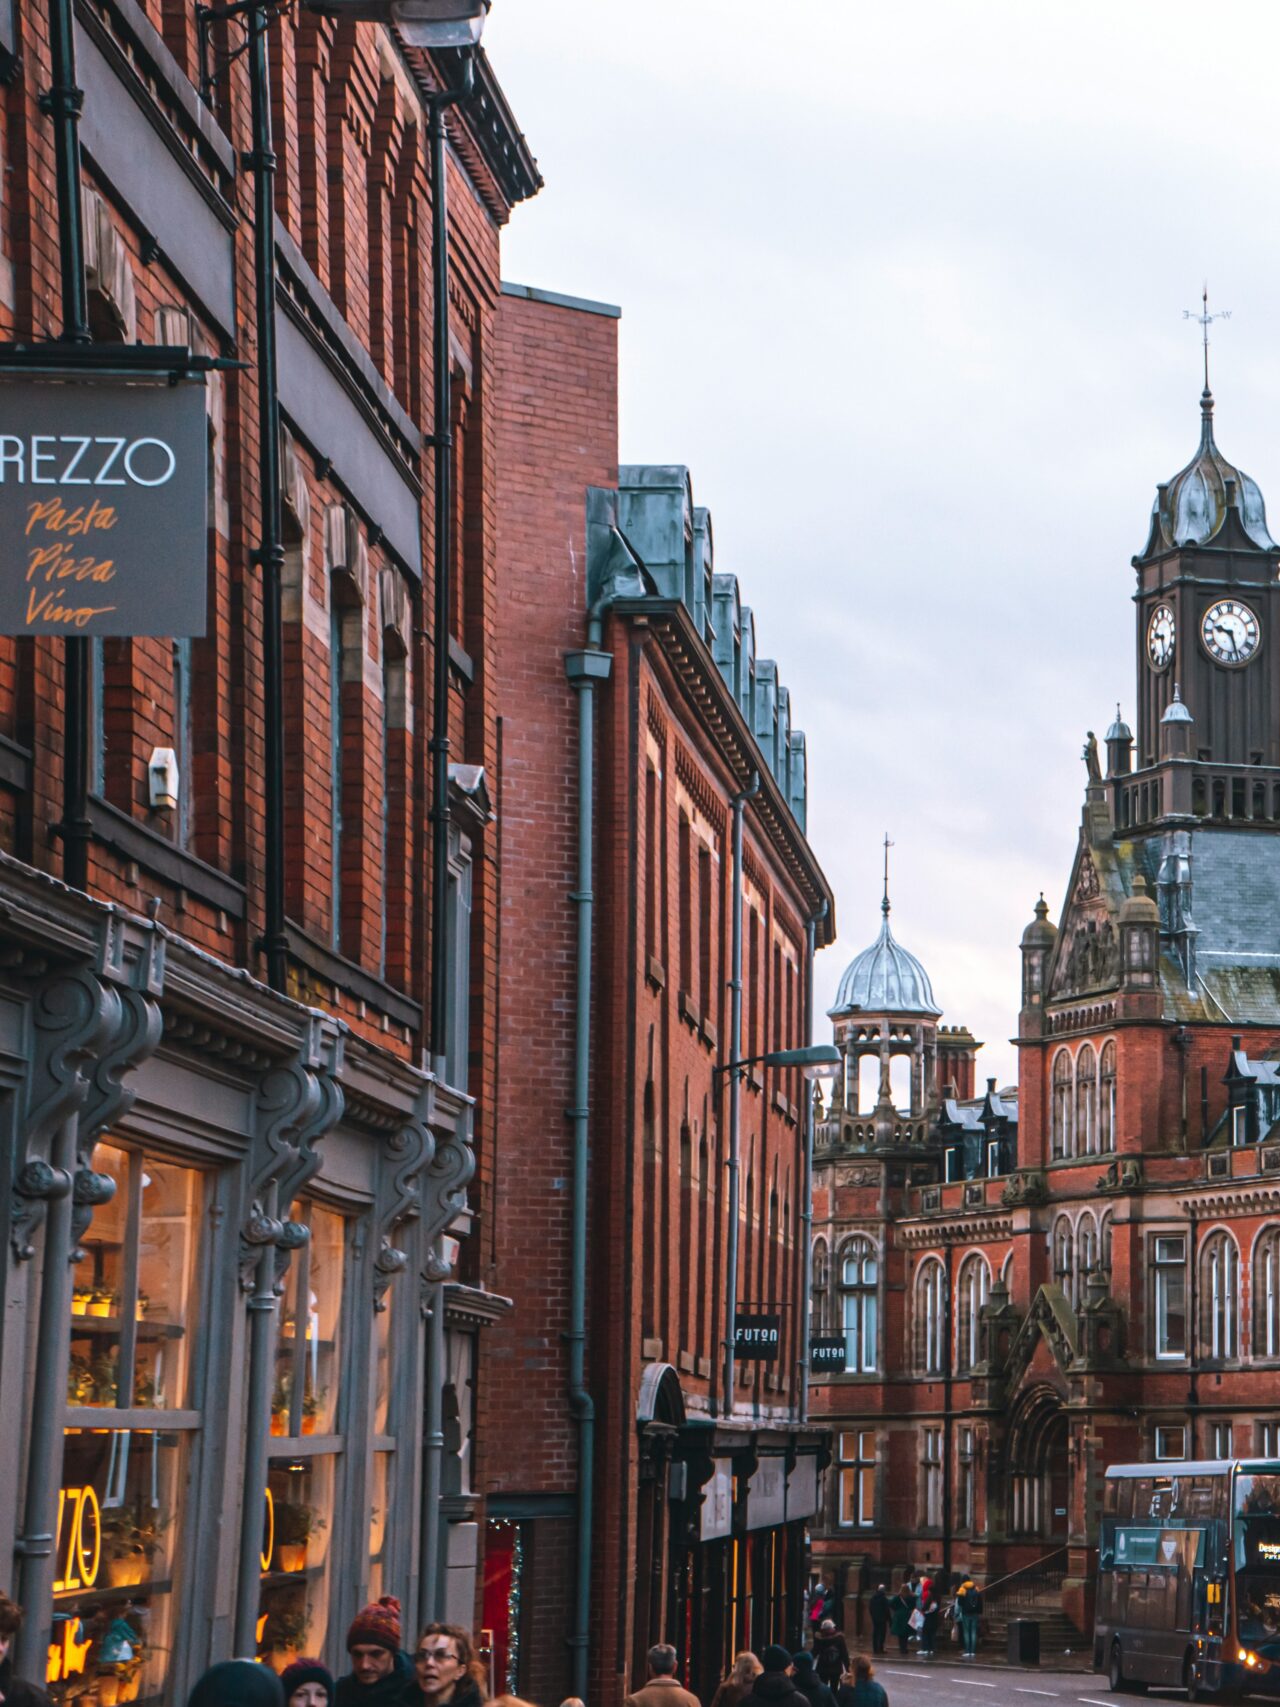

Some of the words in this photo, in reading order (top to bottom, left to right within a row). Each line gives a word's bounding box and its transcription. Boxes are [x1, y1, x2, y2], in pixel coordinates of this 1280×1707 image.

[25, 497, 118, 535] Pasta
[26, 544, 117, 583] Pizza
[26, 587, 117, 625] Vino
[736, 1328, 778, 1342] FUTON
[812, 1348, 845, 1358] FUTON
